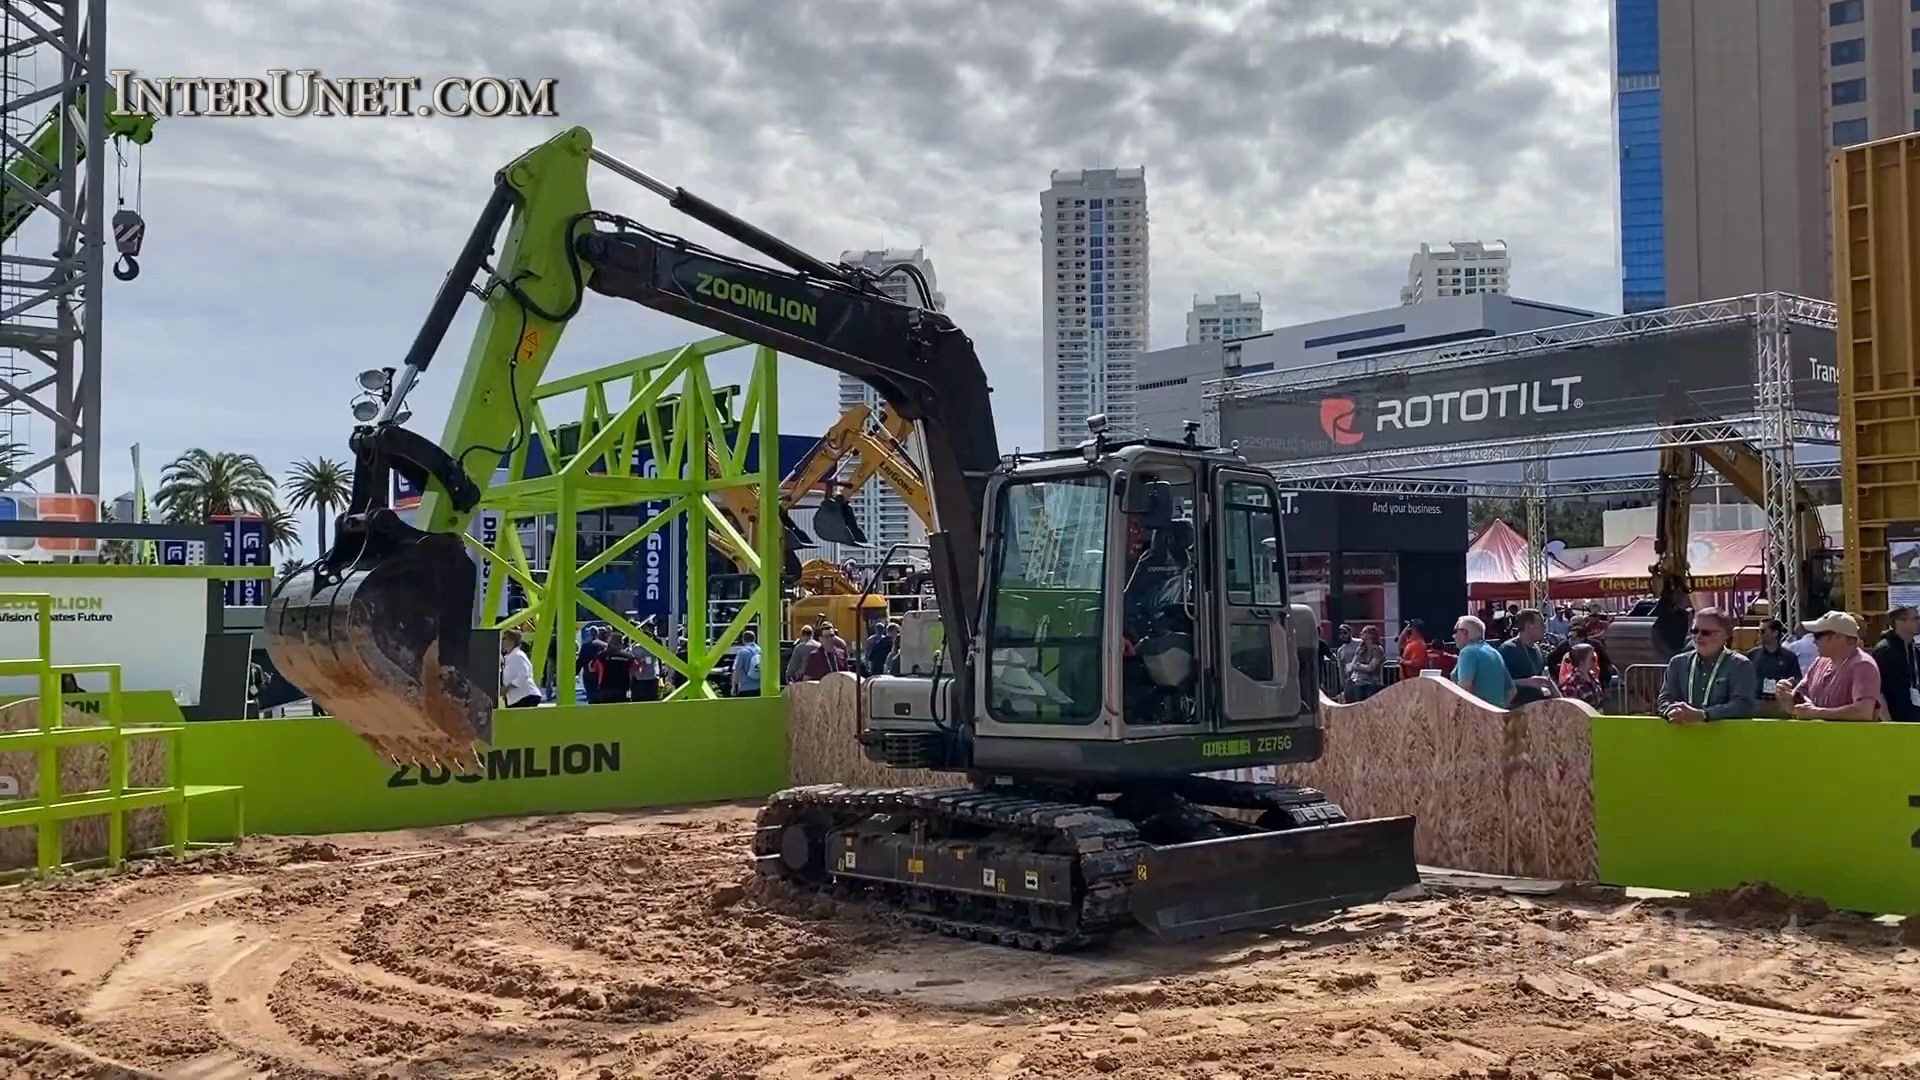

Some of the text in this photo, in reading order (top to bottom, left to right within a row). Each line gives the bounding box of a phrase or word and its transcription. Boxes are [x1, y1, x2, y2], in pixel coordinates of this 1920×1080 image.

[696, 272, 817, 326] ZOOMLION
[1372, 502, 1443, 515] And your business.
[646, 499, 661, 600] LIGONG
[1600, 577, 1649, 591] Clevela
[78, 612, 113, 621] Future
[1257, 735, 1292, 752] ZE75G
